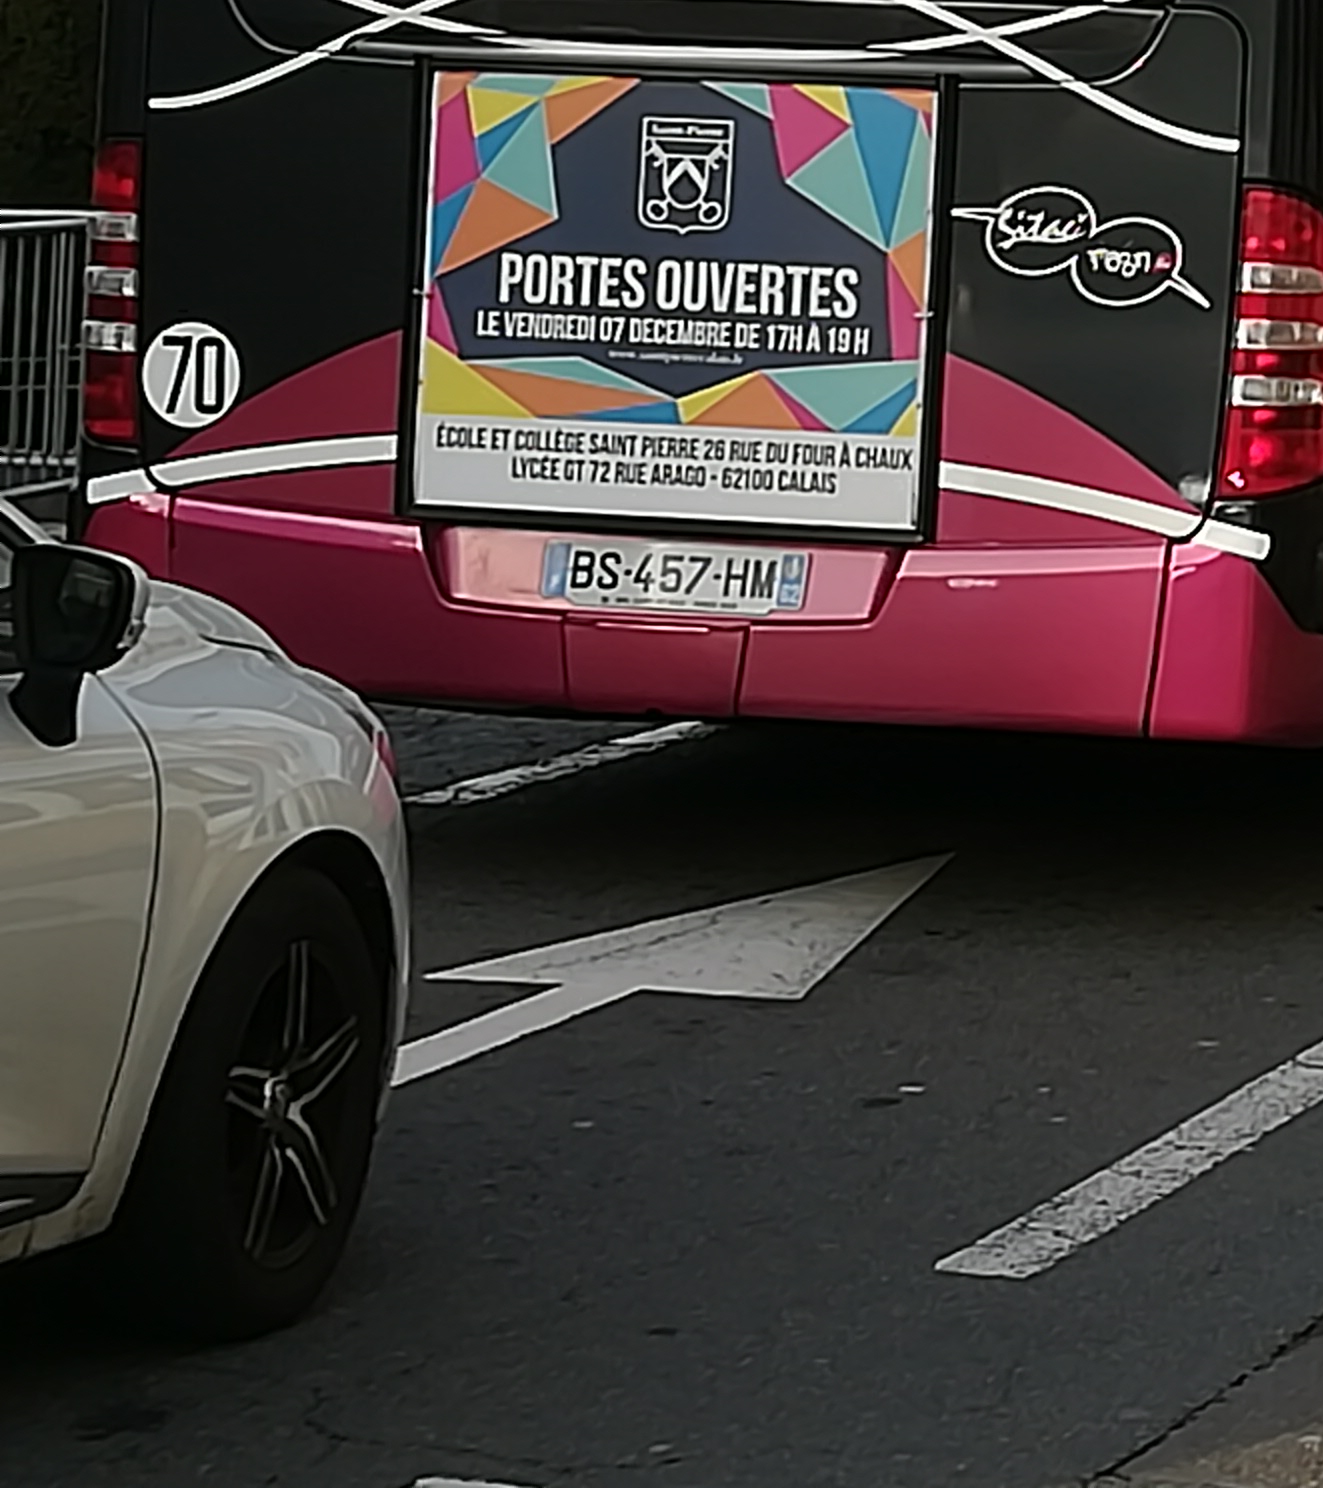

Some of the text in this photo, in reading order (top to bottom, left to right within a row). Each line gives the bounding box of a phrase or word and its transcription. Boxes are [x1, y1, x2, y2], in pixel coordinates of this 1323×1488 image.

[498, 252, 860, 320] PORTES OUVERTES
[476, 309, 501, 337] LE
[503, 311, 597, 342] VENDREDI
[600, 316, 626, 343] 07
[628, 317, 732, 349] DECEMBRE
[733, 322, 762, 350] DE
[805, 321, 822, 353] À
[162, 335, 227, 415] 70
[435, 420, 488, 450] ÉCOLE
[491, 428, 512, 451] ET
[514, 426, 586, 455] COLLÈGE
[588, 432, 638, 458] SAINT
[640, 434, 700, 461] PIERRE
[729, 440, 763, 463] RUE
[765, 441, 790, 464] DU
[792, 442, 837, 467] FOUR
[838, 440, 852, 468] À
[855, 445, 914, 472] CHAUX
[510, 455, 561, 481] LYCÉE
[589, 460, 612, 484] 72
[614, 461, 648, 485] RUE
[649, 463, 707, 488] ARAGO
[721, 466, 775, 491] 62100
[777, 469, 838, 495] CALAIS
[570, 548, 779, 600] BS-457-HM
